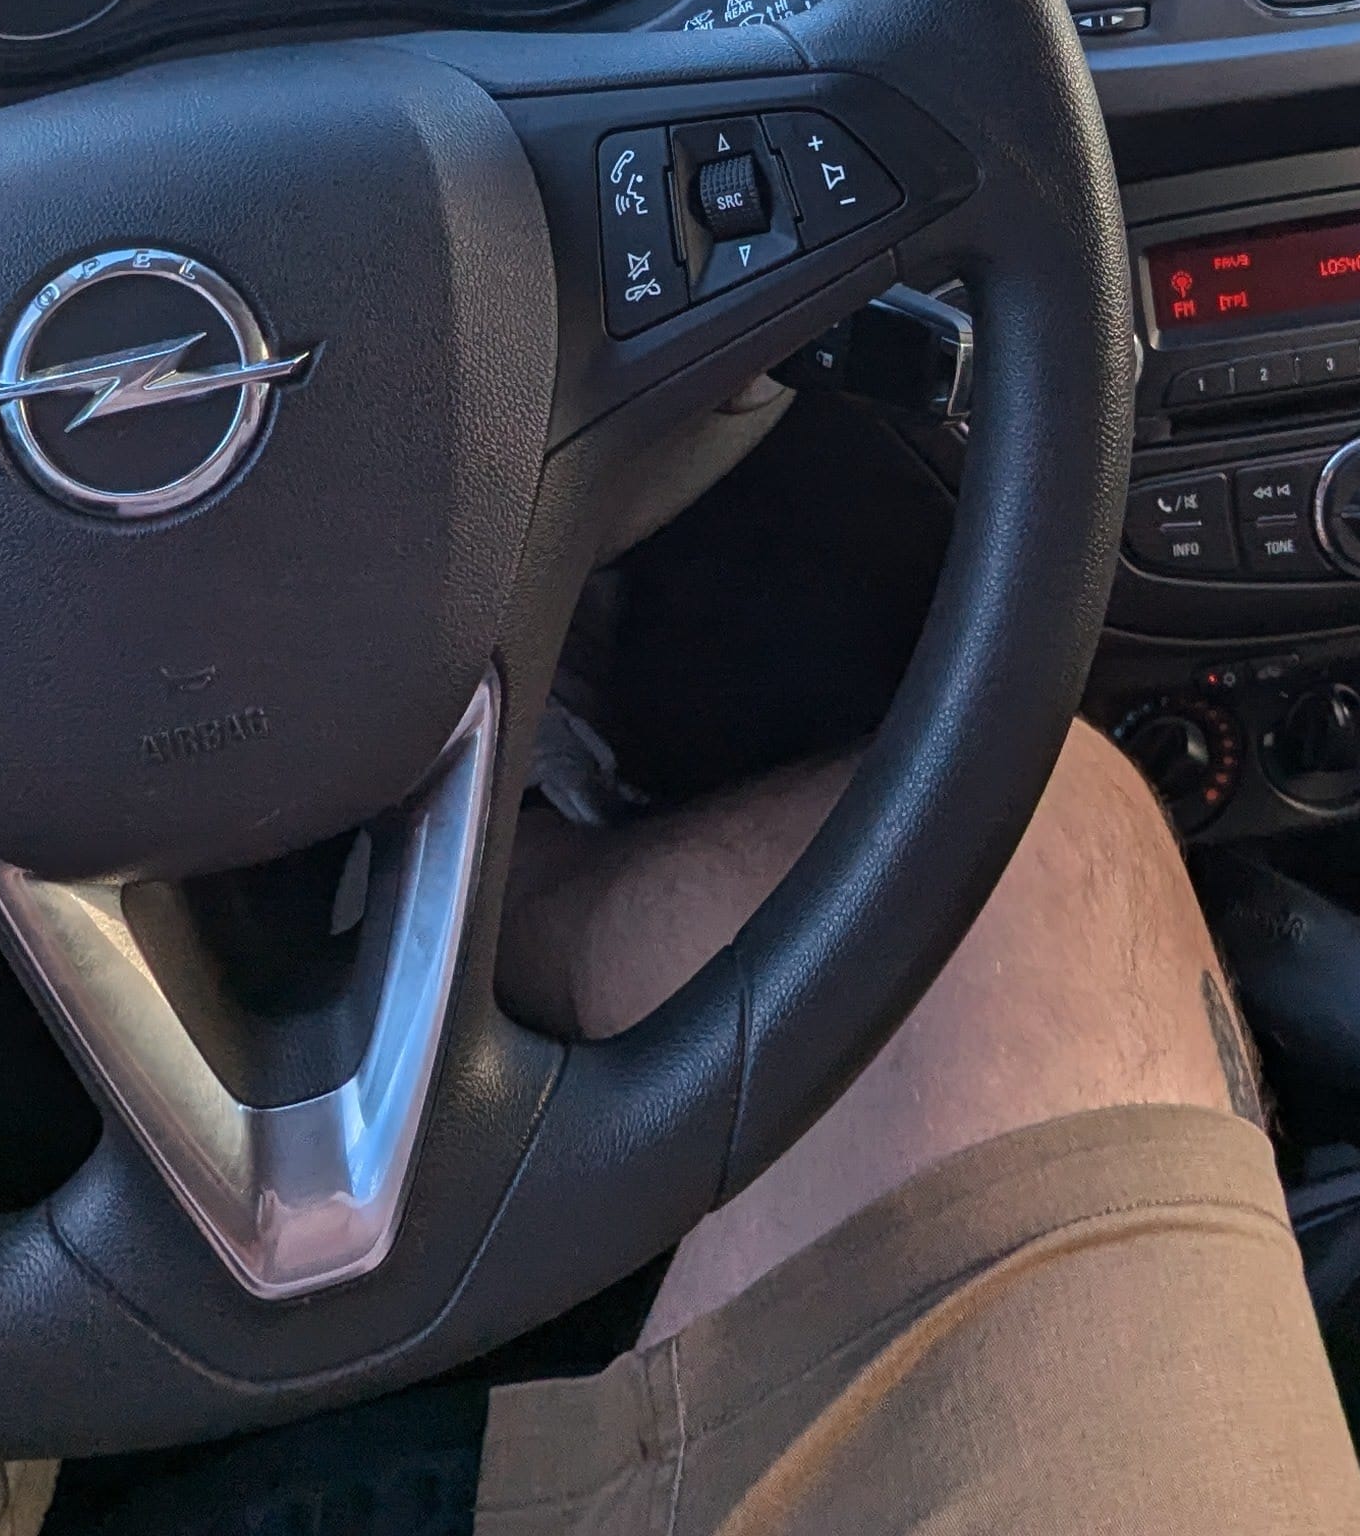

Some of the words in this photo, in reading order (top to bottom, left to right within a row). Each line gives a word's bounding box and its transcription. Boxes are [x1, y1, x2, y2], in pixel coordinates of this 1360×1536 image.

[724, 0, 754, 22] REAR
[716, 192, 744, 211] SRC
[34, 249, 197, 310] OPEL
[1173, 300, 1196, 319] FM
[1326, 357, 1335, 371] 3
[1259, 367, 1268, 381] 2
[1198, 378, 1205, 392] 1
[1172, 542, 1200, 557] INFO
[1264, 539, 1295, 556] TONE
[141, 706, 273, 762] AIRBAG
